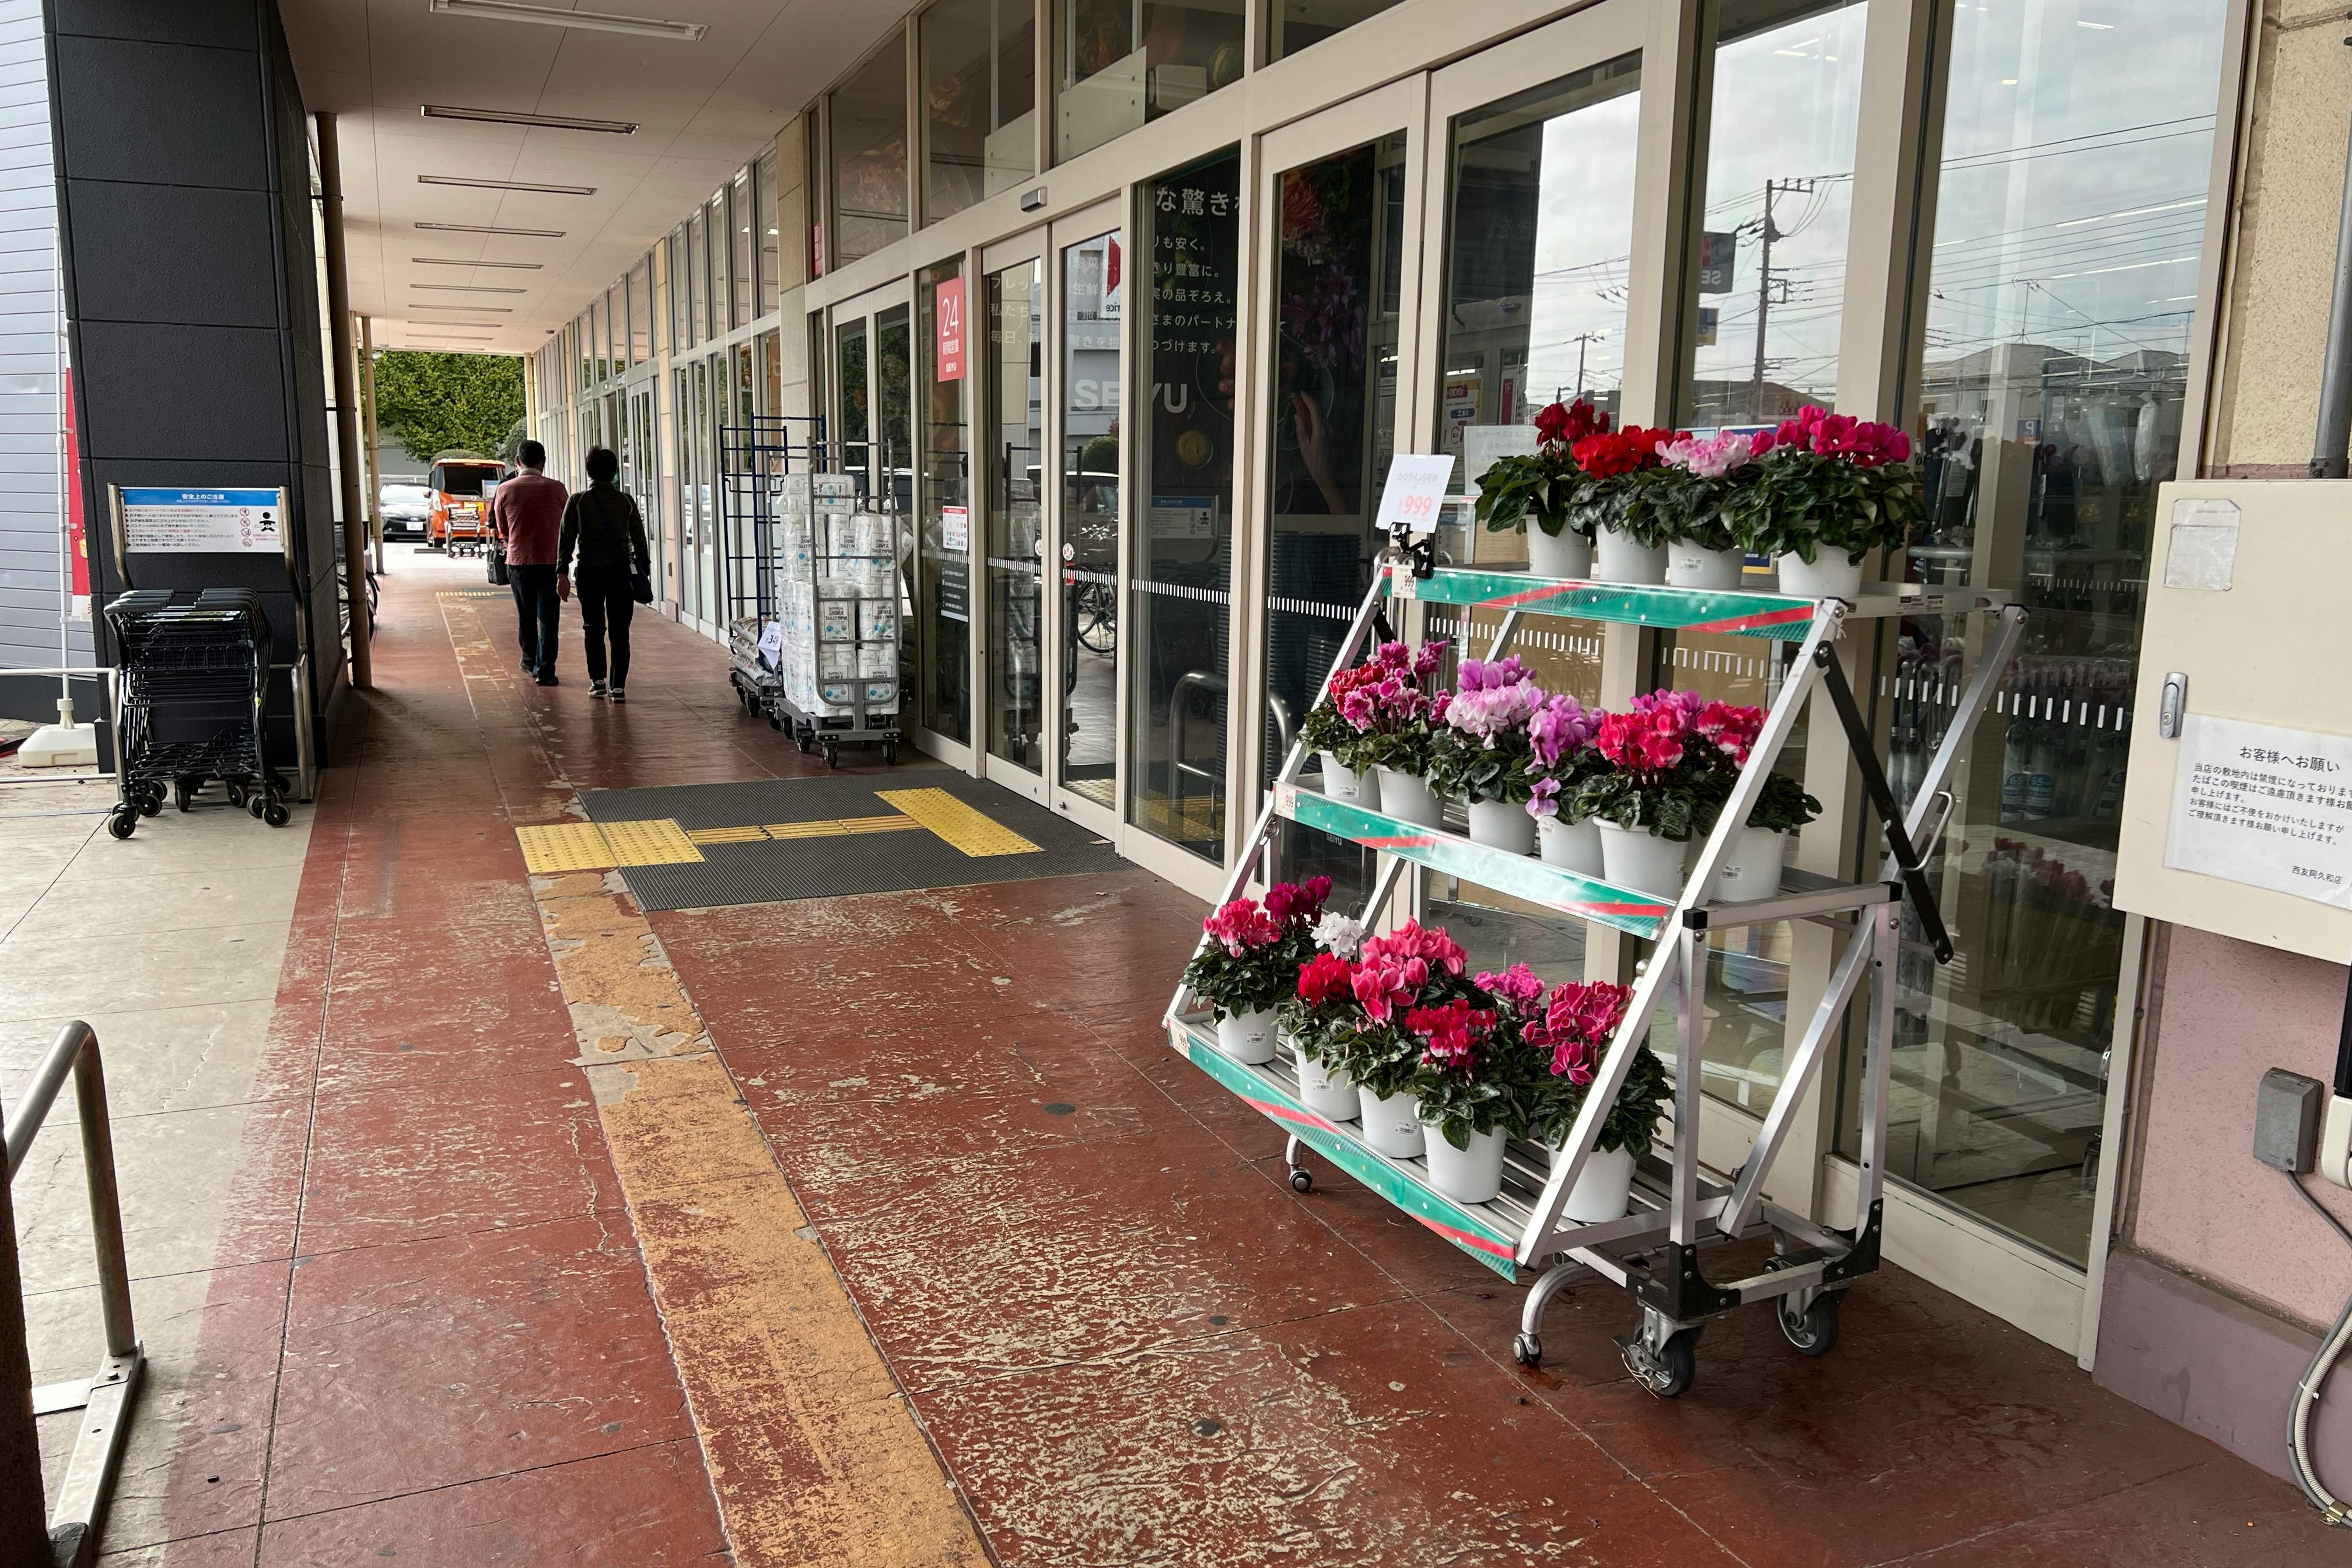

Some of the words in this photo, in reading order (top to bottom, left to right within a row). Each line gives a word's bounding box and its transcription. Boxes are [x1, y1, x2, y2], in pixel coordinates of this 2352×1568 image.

[942, 294, 959, 337] 24
[2240, 747, 2340, 772] お客様へお願い
[2191, 786, 2244, 803] 申し上げます。
[2189, 798, 2345, 833] お客様にはご不便をおかけいたしますが
[1326, 833, 1342, 846] SEIYU
[2292, 865, 2343, 885] 西友阿久和店
